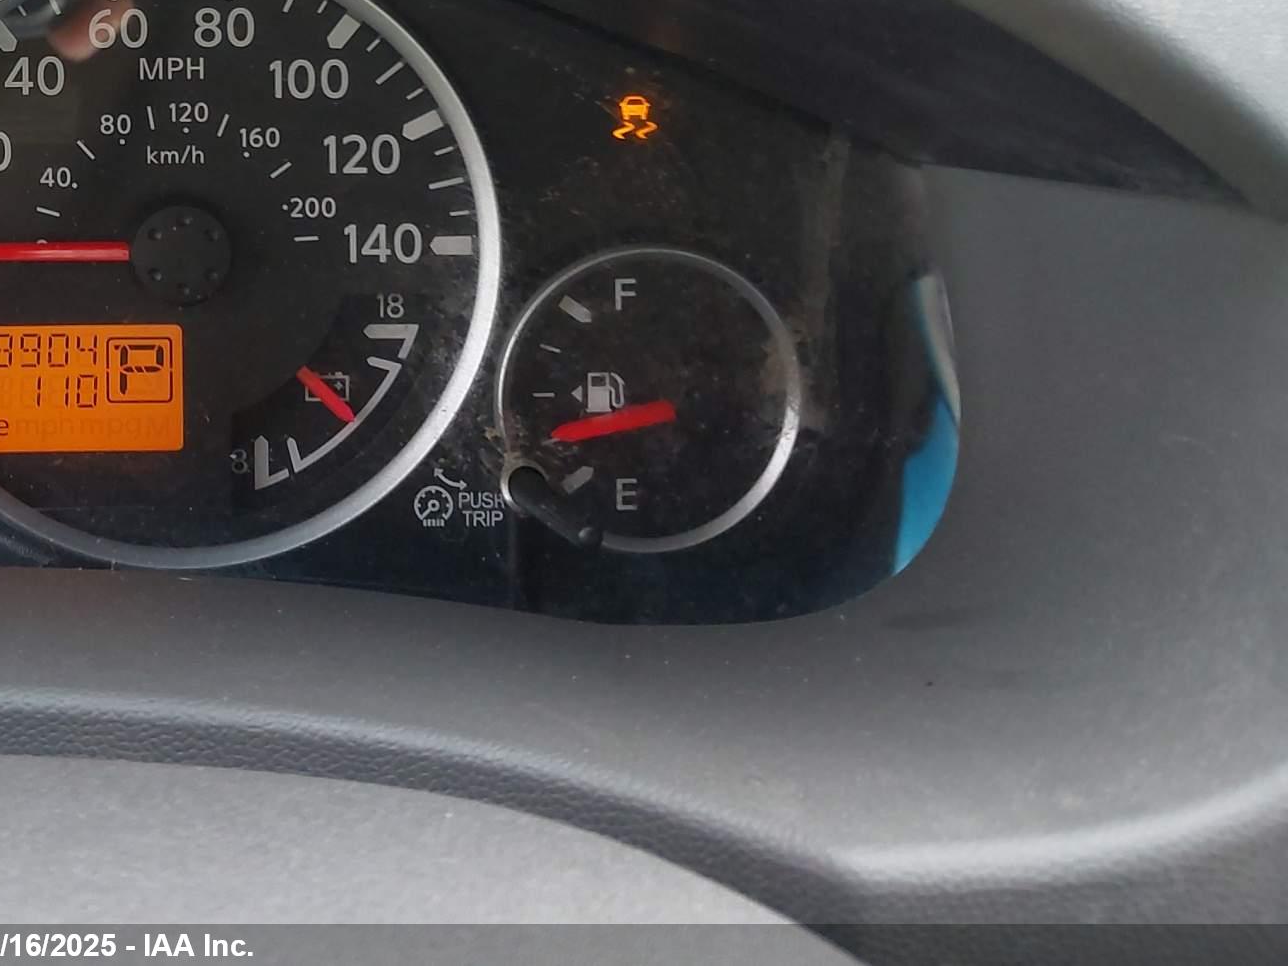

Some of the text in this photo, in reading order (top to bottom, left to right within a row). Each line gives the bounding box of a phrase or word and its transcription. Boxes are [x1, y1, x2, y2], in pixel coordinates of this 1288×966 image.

[89, 8, 148, 49] 60
[194, 7, 255, 48] 80
[4, 56, 65, 96] 40
[139, 57, 205, 81] MPH
[269, 58, 349, 100] 100
[100, 114, 132, 136] 80
[169, 103, 209, 124] 120
[240, 127, 280, 149] 160
[146, 145, 206, 166] km/h
[323, 134, 400, 175] 120
[40, 167, 71, 189] 40
[290, 198, 337, 219] 200
[344, 223, 422, 264] 140
[377, 294, 404, 318] 18
[614, 278, 637, 310] F
[113, 344, 164, 395] P
[36, 374, 98, 408] 110
[231, 449, 249, 474] 8
[458, 492, 505, 509] PUSH
[616, 478, 638, 511] E
[462, 511, 504, 527] TRIP
